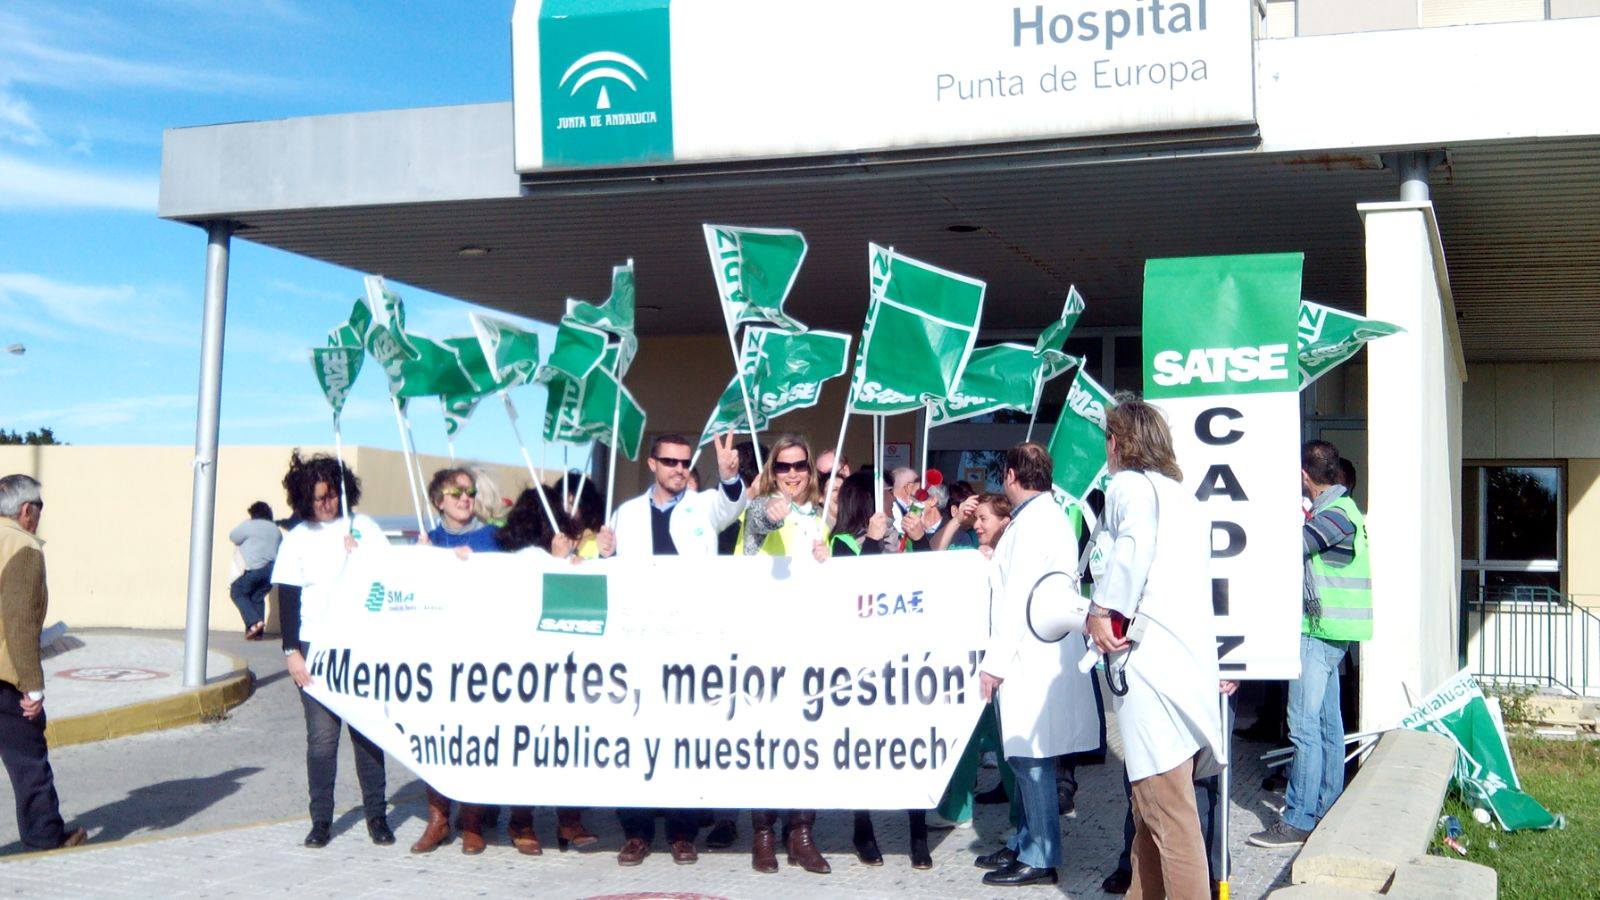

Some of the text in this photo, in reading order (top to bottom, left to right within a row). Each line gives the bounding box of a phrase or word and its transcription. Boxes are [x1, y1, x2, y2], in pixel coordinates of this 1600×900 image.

[1012, 0, 1208, 50] Hospital
[936, 59, 1209, 102] Punta de Europa
[556, 111, 657, 130] JUNTA DE ANDALUCIA
[1152, 343, 1289, 387] SATSE
[1193, 406, 1250, 672] CADIZ
[857, 590, 924, 619] USAE
[450, 650, 642, 717] recortes,
[662, 653, 786, 721] mejor
[394, 722, 958, 781] anidad Pública y nuestros derech
